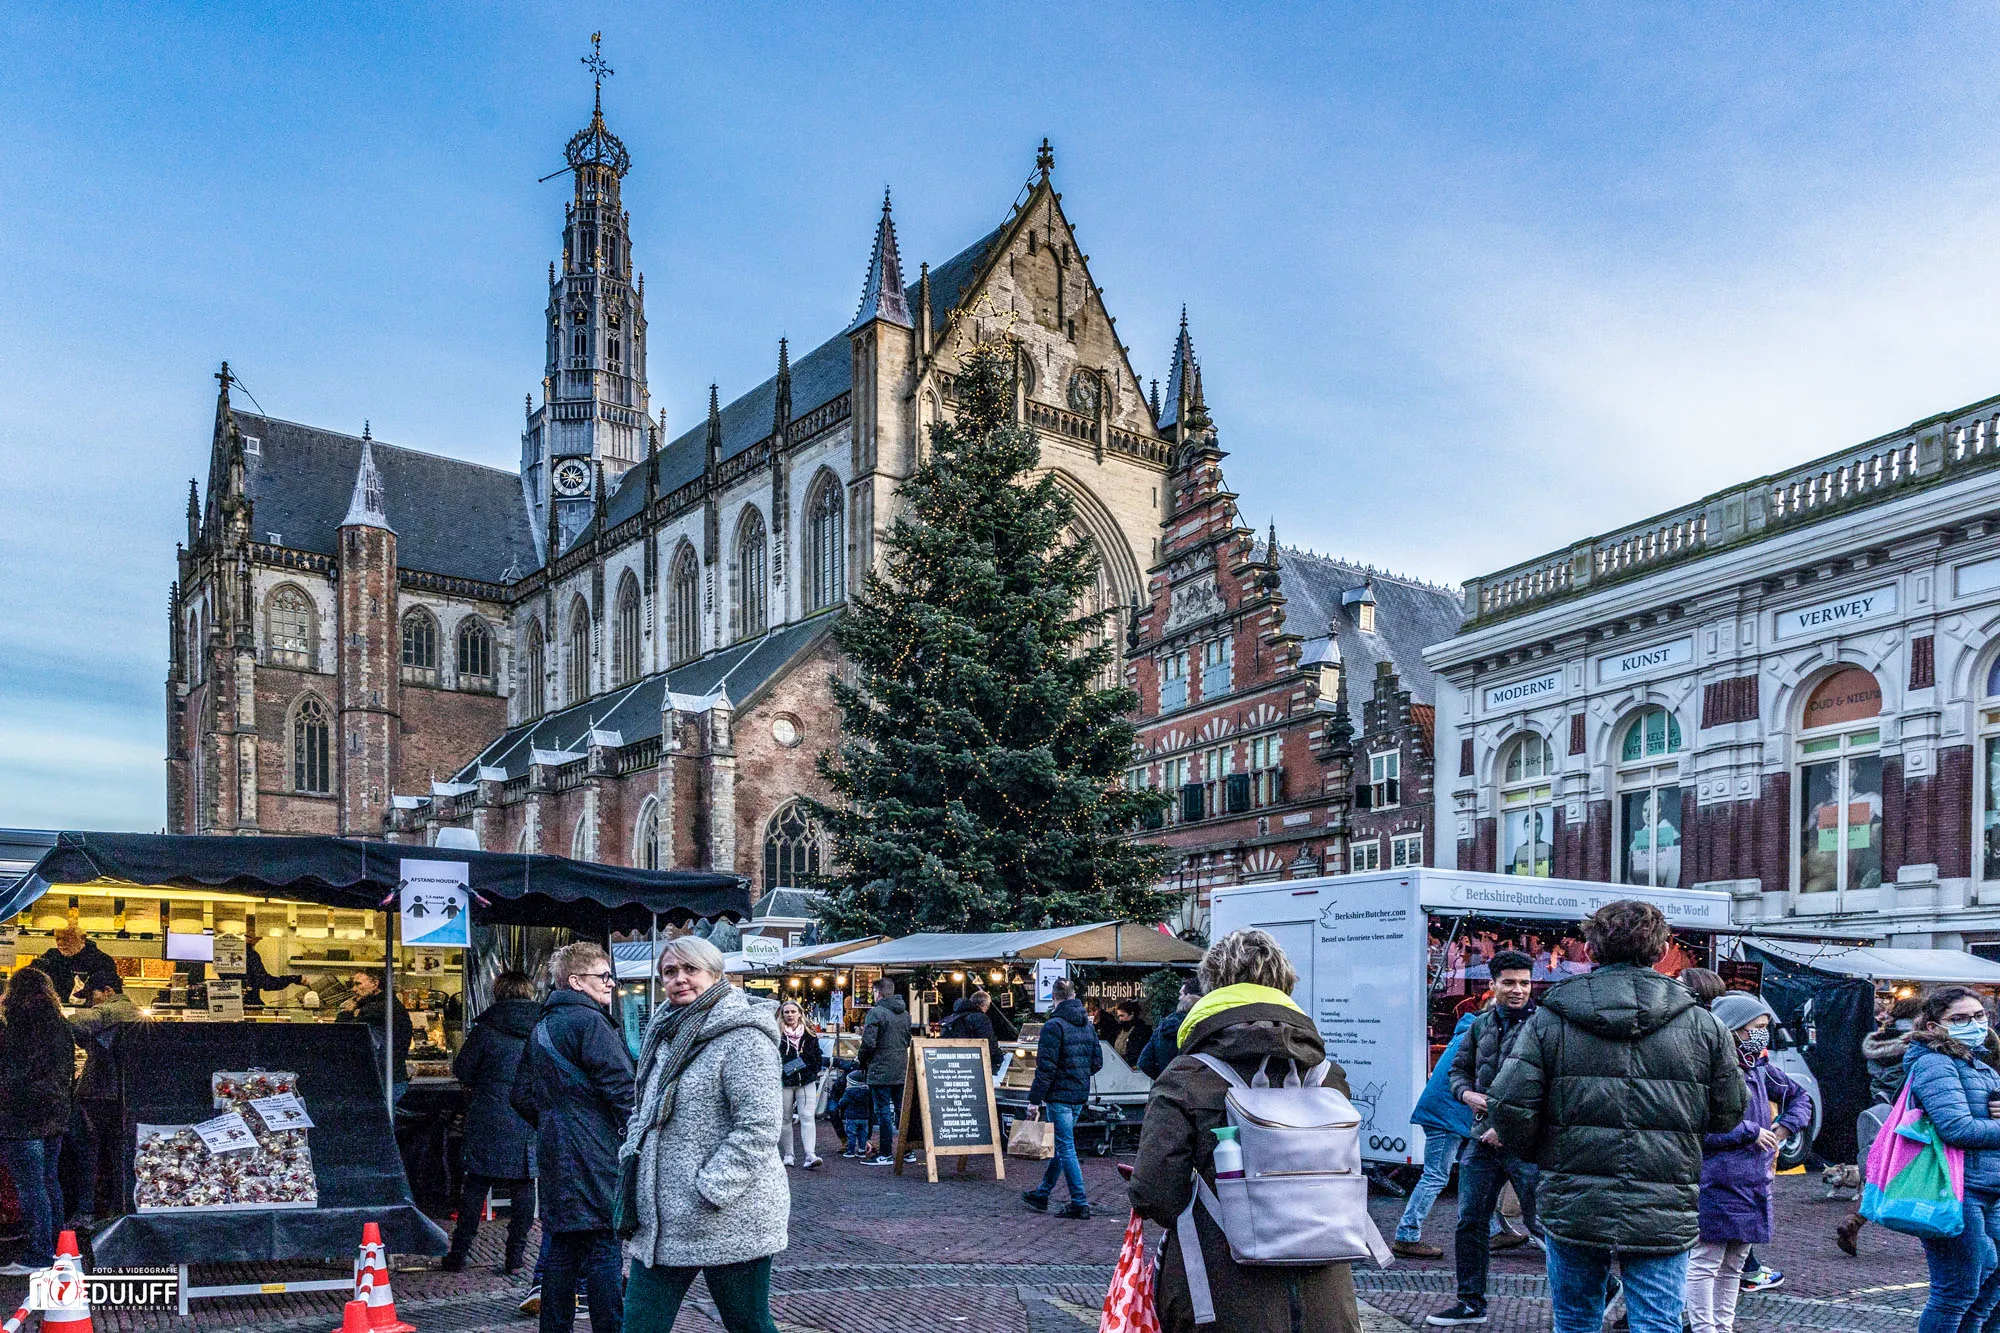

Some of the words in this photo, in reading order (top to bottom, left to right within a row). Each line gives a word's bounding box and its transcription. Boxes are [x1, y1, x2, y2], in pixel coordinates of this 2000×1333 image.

[1799, 597, 1874, 628] VERWEY
[1622, 648, 1670, 672] KUNST
[1493, 678, 1555, 704] MODERNE
[1634, 730, 1666, 745] PXELS
[1509, 758, 1530, 768] JOG
[1466, 888, 1578, 908] BerkshireButcher.com
[1656, 902, 1664, 913] in
[1667, 903, 1681, 915] the
[1683, 904, 1709, 917] World
[1334, 909, 1406, 921] BerkshireButcher.com
[1321, 935, 1337, 943] Bestel
[1347, 934, 1371, 942] favoriete
[1386, 932, 1404, 940] online
[1102, 981, 1132, 1001] English
